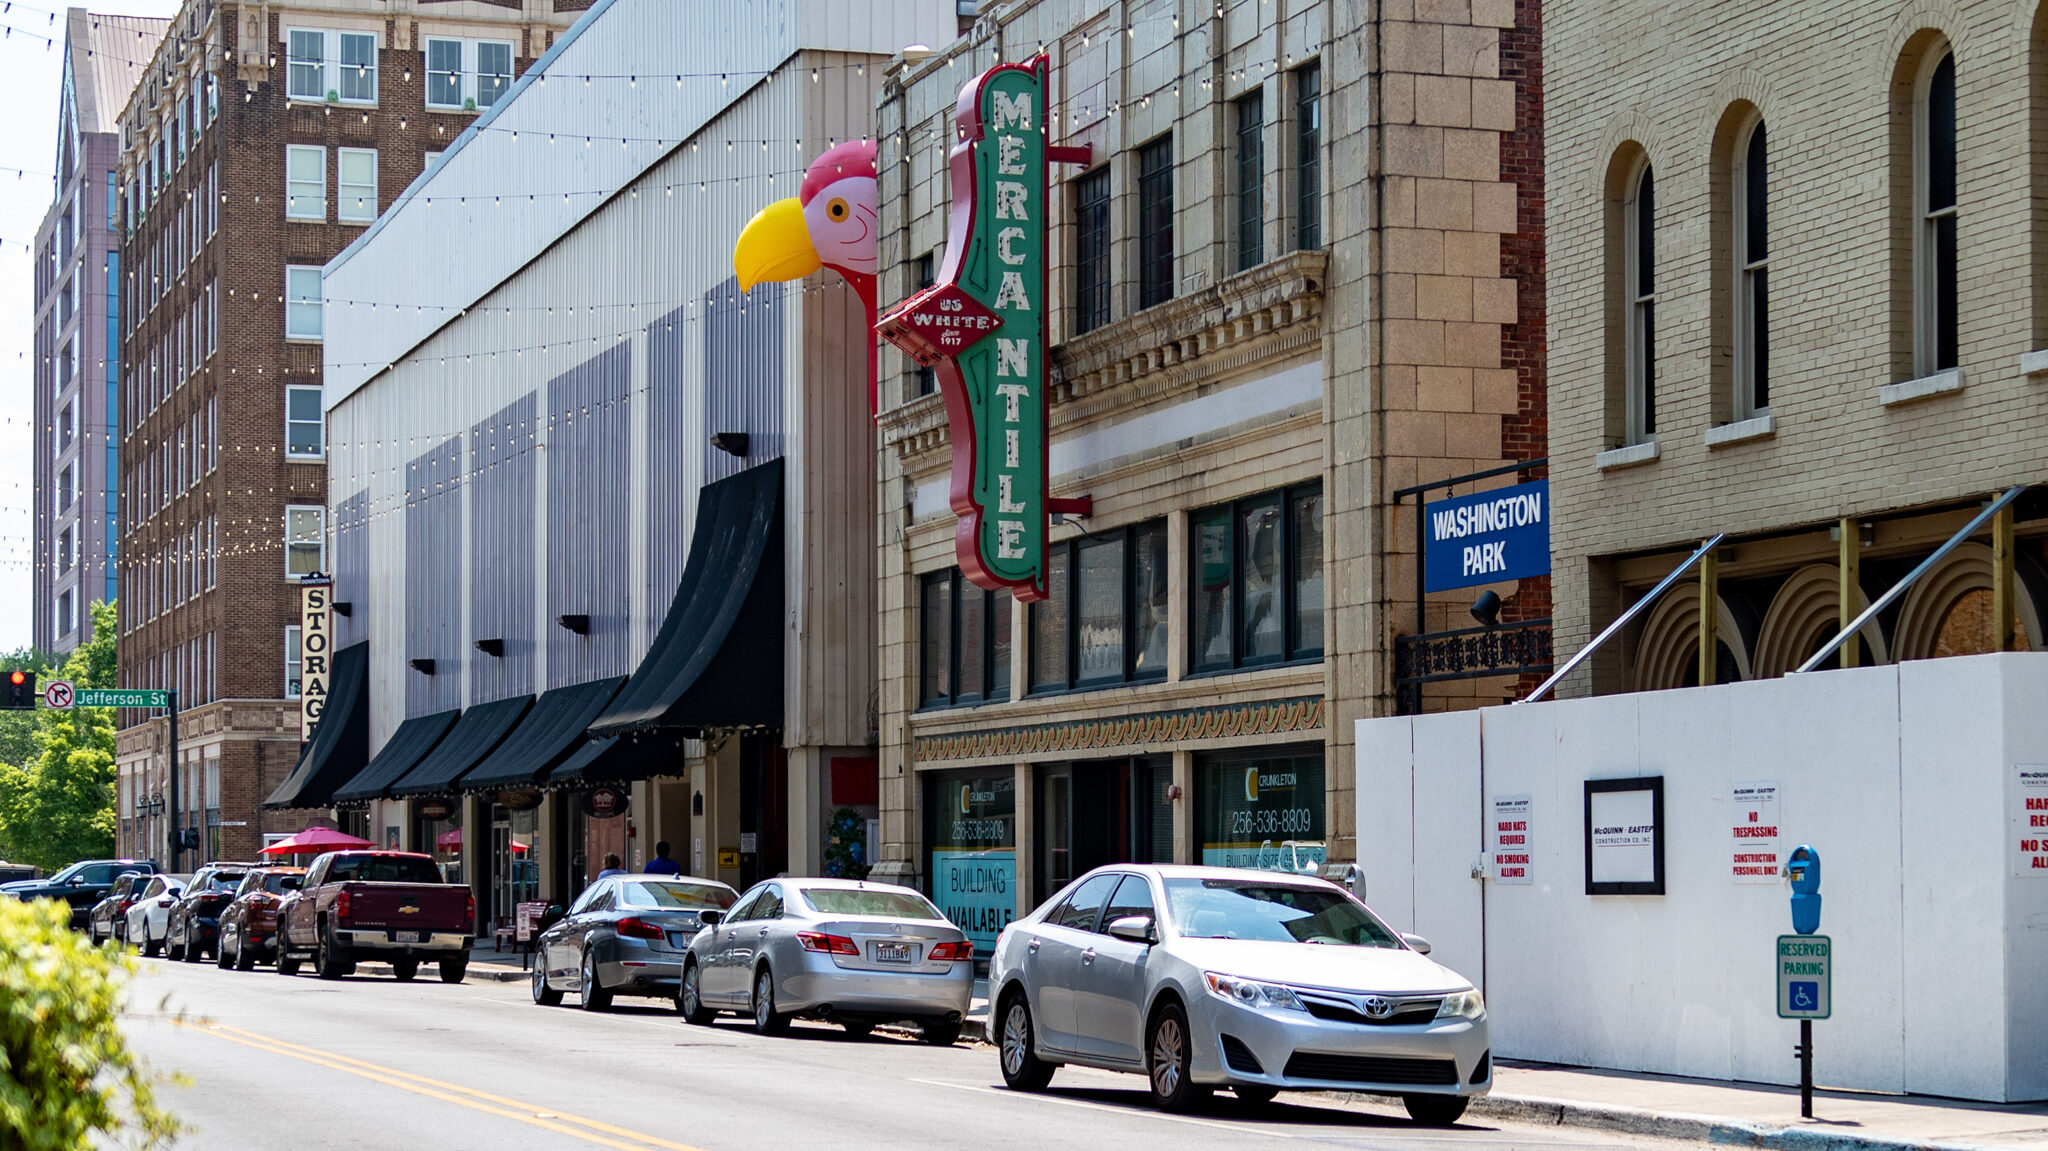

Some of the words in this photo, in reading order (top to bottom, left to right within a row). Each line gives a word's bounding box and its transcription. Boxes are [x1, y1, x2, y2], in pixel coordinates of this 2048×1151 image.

[940, 299, 963, 311] US
[912, 312, 990, 329] WHITE
[993, 90, 1032, 559] MERCANTILE
[941, 329, 960, 338] Since
[940, 337, 961, 345] 1917
[1433, 492, 1541, 541] WASHINGTON
[1463, 540, 1506, 576] PARK
[77, 692, 143, 705] Jefferson
[151, 692, 165, 705] St
[1258, 773, 1297, 787] CRUNKLETON
[1232, 808, 1311, 833] 256-536-8809
[1748, 812, 1758, 822] NO
[2030, 815, 2048, 827] RE
[952, 820, 1003, 840] 256-536-8809
[1498, 822, 1512, 831] HARD
[1513, 821, 1527, 831] HATS
[1594, 827, 1623, 835] McQUINN
[1628, 825, 1655, 833] EASTEP
[1732, 826, 1777, 838] TRESPASSING
[1499, 834, 1525, 845] REQUIRED
[2021, 839, 2038, 852] NO
[1226, 854, 1260, 868] BUILDING
[1496, 854, 1503, 864] NO
[1504, 854, 1529, 864] SMOKING
[1733, 854, 1776, 863] CONSTRUCTION
[2032, 856, 2048, 869] AL
[1501, 867, 1525, 877] ALLOWED
[1733, 866, 1763, 875] PERSONNEL
[1764, 866, 1777, 875] ONLY
[951, 867, 1006, 893] BUILDING
[1780, 943, 1827, 957] RESERVED
[1784, 962, 1824, 976] PARKING
